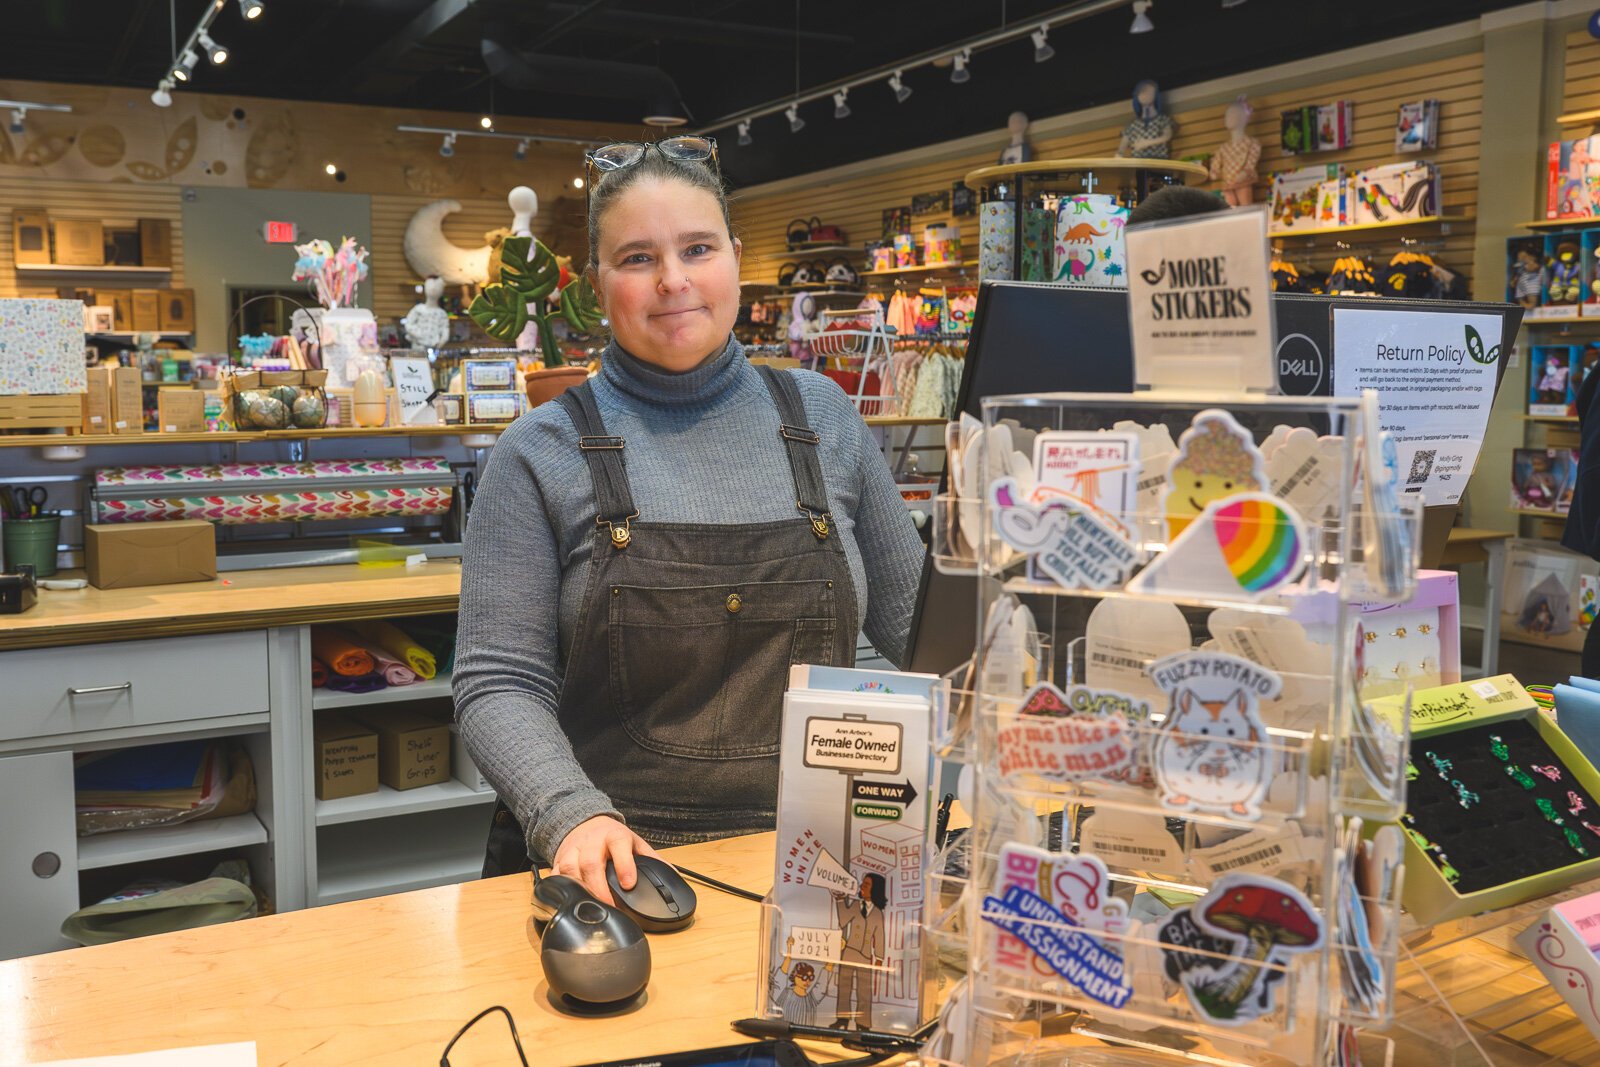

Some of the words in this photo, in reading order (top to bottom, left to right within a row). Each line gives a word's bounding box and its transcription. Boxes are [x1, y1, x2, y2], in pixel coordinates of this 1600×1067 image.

[1168, 256, 1227, 288] MORE
[1151, 287, 1252, 320] STICKERS
[1377, 344, 1423, 361] Return
[1428, 345, 1466, 365] Policy
[1280, 359, 1318, 376] DELL
[400, 384, 428, 394] STILL
[1065, 527, 1085, 547] ILL
[1084, 542, 1109, 566] BUT
[1075, 516, 1135, 563] MENTALLY
[1044, 553, 1076, 582] CHILL
[1055, 539, 1108, 583] TOTALLY
[1156, 660, 1210, 688] FUZZY
[1212, 660, 1273, 695] POTATO
[407, 737, 433, 751] Shelf
[811, 735, 852, 749] Female
[855, 738, 896, 752] Owned
[1025, 727, 1054, 743] me
[1057, 722, 1103, 745] like
[416, 751, 440, 763] Liner
[816, 749, 854, 759] Businesses
[855, 752, 887, 762] Directory
[999, 744, 1060, 777] white
[1063, 743, 1127, 772] man
[407, 765, 436, 779] Grips
[858, 785, 879, 796] ONE
[881, 787, 904, 798] WAY
[856, 806, 899, 817] FORWARD
[783, 828, 813, 883] WOMEN
[862, 839, 896, 856] WOMEN
[796, 839, 822, 884] UNITE
[856, 857, 887, 872] OWNED
[816, 867, 850, 886] VOLUME
[850, 878, 856, 890] 1
[798, 931, 832, 943] JULY
[1007, 889, 1018, 903] I
[1019, 894, 1123, 979] UNDERSTAND
[799, 945, 830, 957] 2024
[986, 900, 1019, 928] THE
[1017, 921, 1129, 1007] ASSIGNMENT
